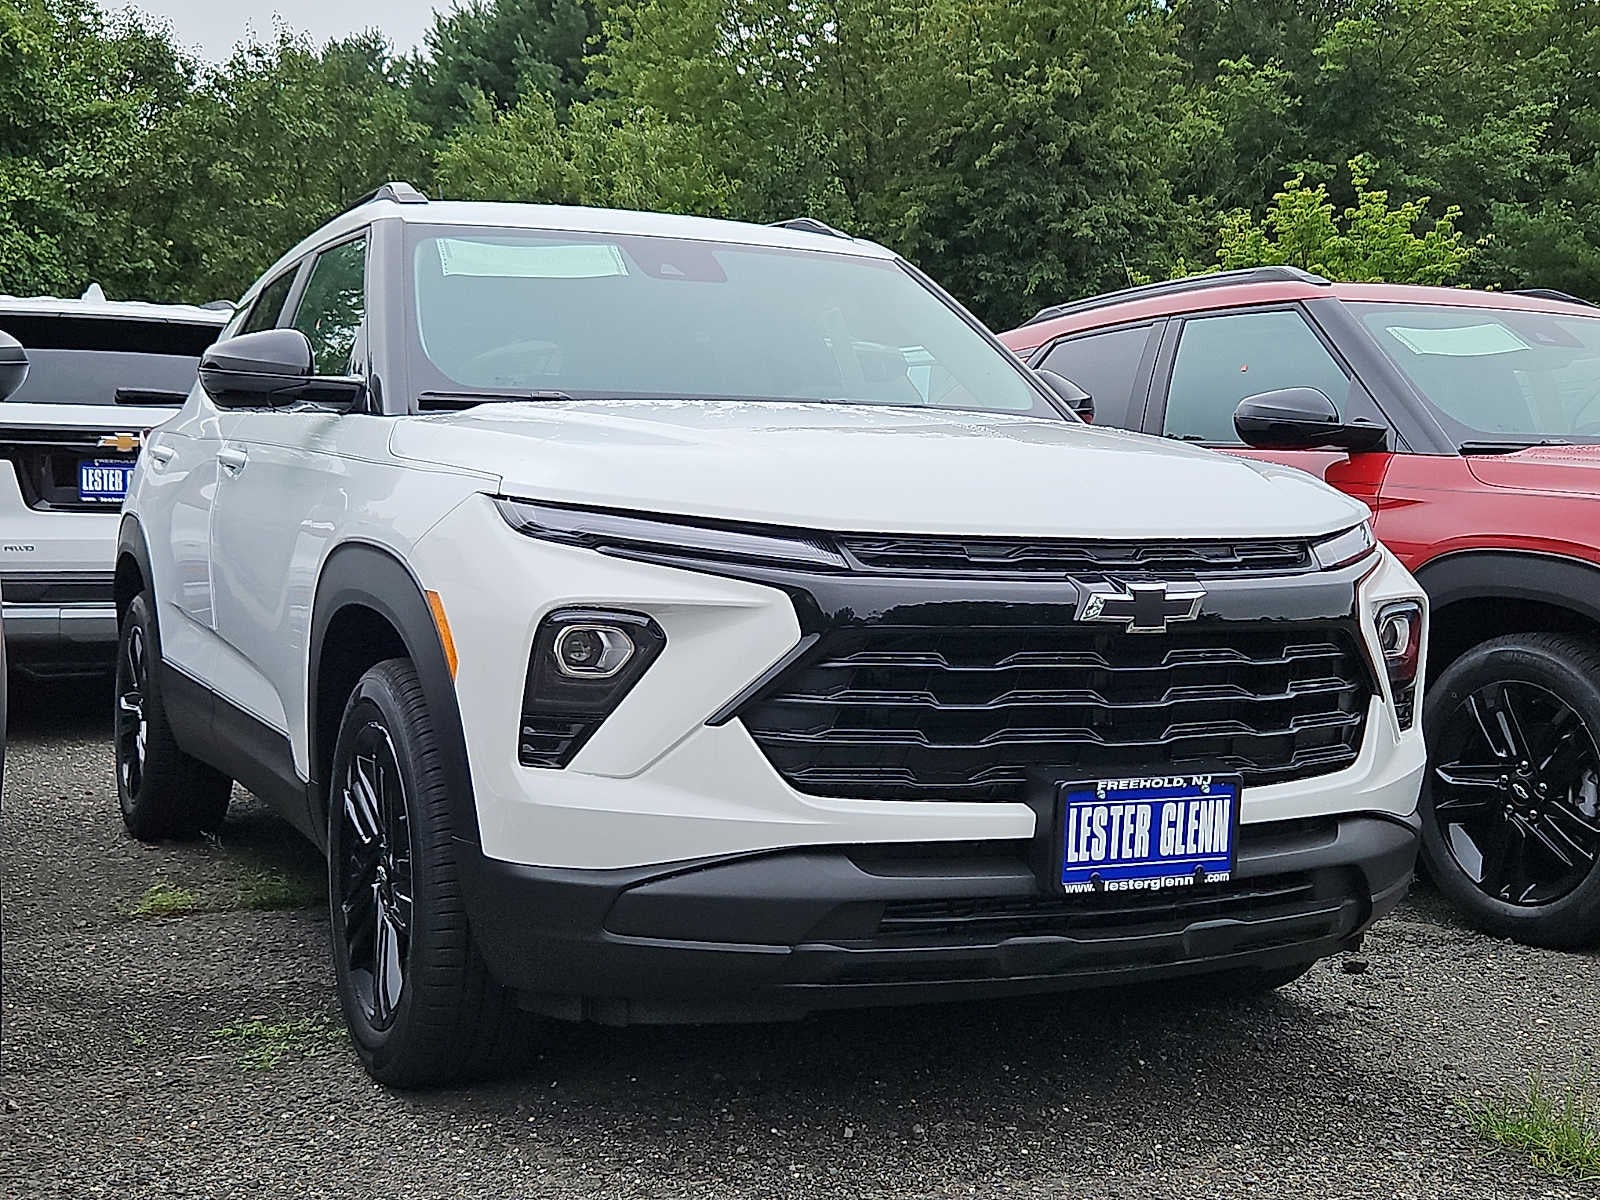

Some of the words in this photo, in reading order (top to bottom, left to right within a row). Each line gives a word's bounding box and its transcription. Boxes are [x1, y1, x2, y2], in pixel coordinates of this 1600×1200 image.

[82, 469, 123, 491] LESTER
[1096, 777, 1187, 791] FREEHOLD,
[1191, 775, 1211, 787] NJ
[1066, 804, 1152, 863] LESTER
[1159, 799, 1231, 857] GLENN
[1103, 876, 1194, 892] lesterglenn
